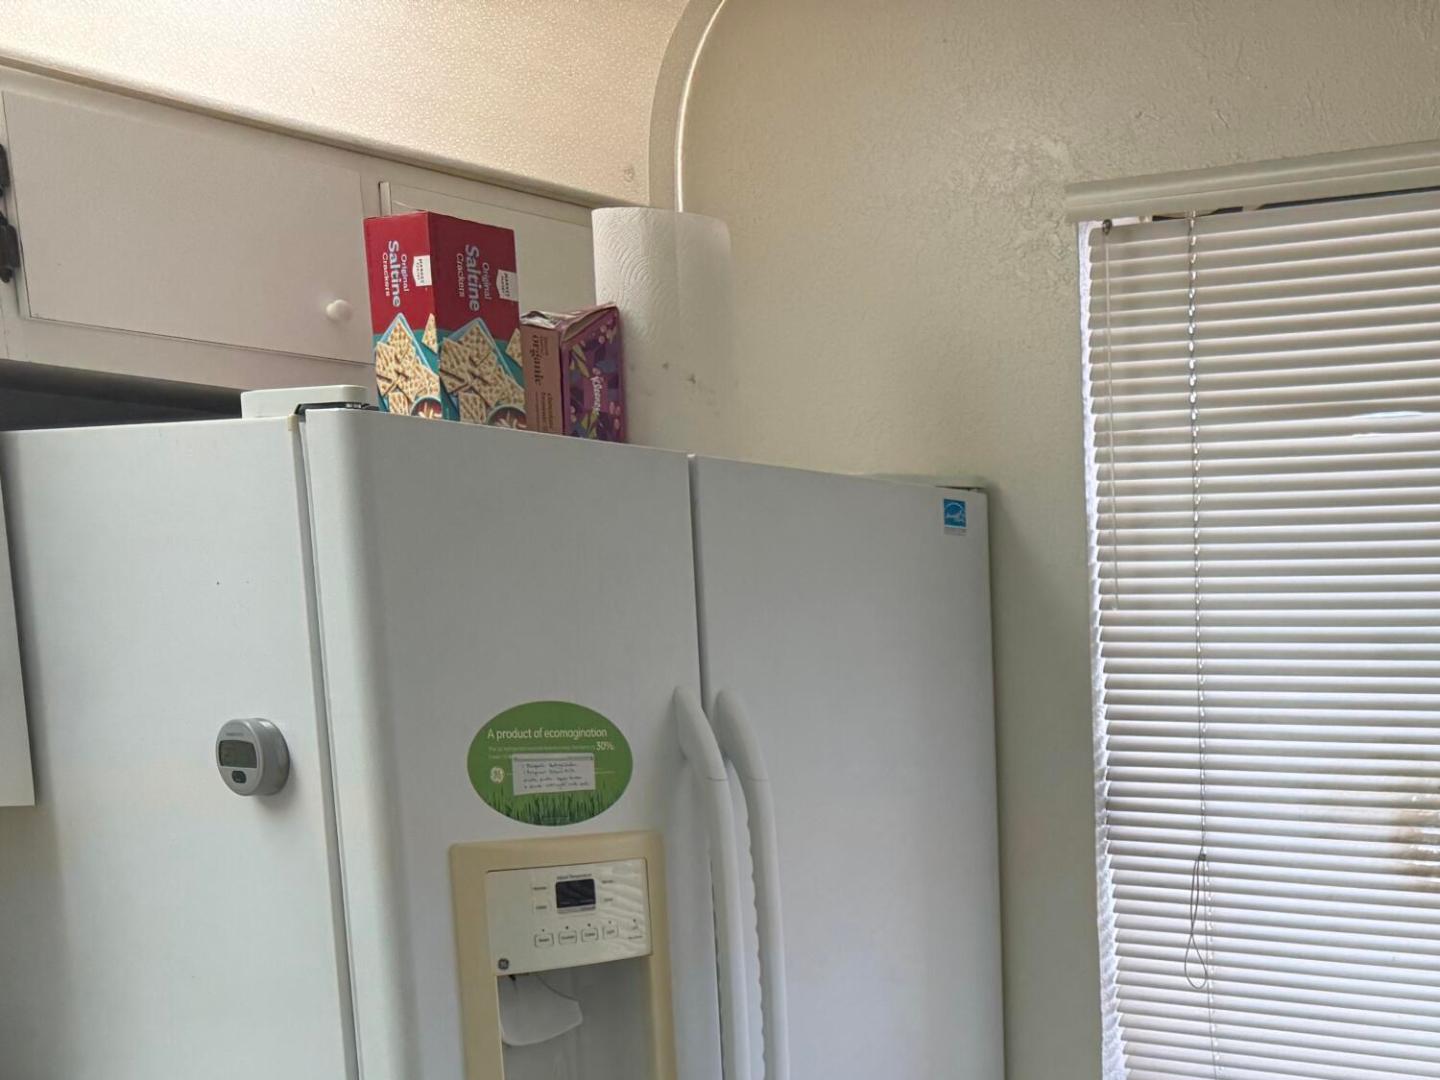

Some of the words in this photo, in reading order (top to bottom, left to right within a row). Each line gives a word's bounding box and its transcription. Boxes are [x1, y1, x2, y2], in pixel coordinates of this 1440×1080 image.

[382, 252, 390, 296] Crackers
[388, 240, 402, 307] Saltine
[400, 254, 410, 292] Original
[456, 253, 466, 298] Crackers
[465, 244, 482, 312] Saltine
[482, 262, 492, 300] Original
[530, 335, 544, 387] organic
[487, 728, 495, 739] A
[496, 728, 532, 740] product
[534, 727, 543, 738] of
[544, 728, 608, 740] ecomagination
[596, 741, 615, 751] 30%
